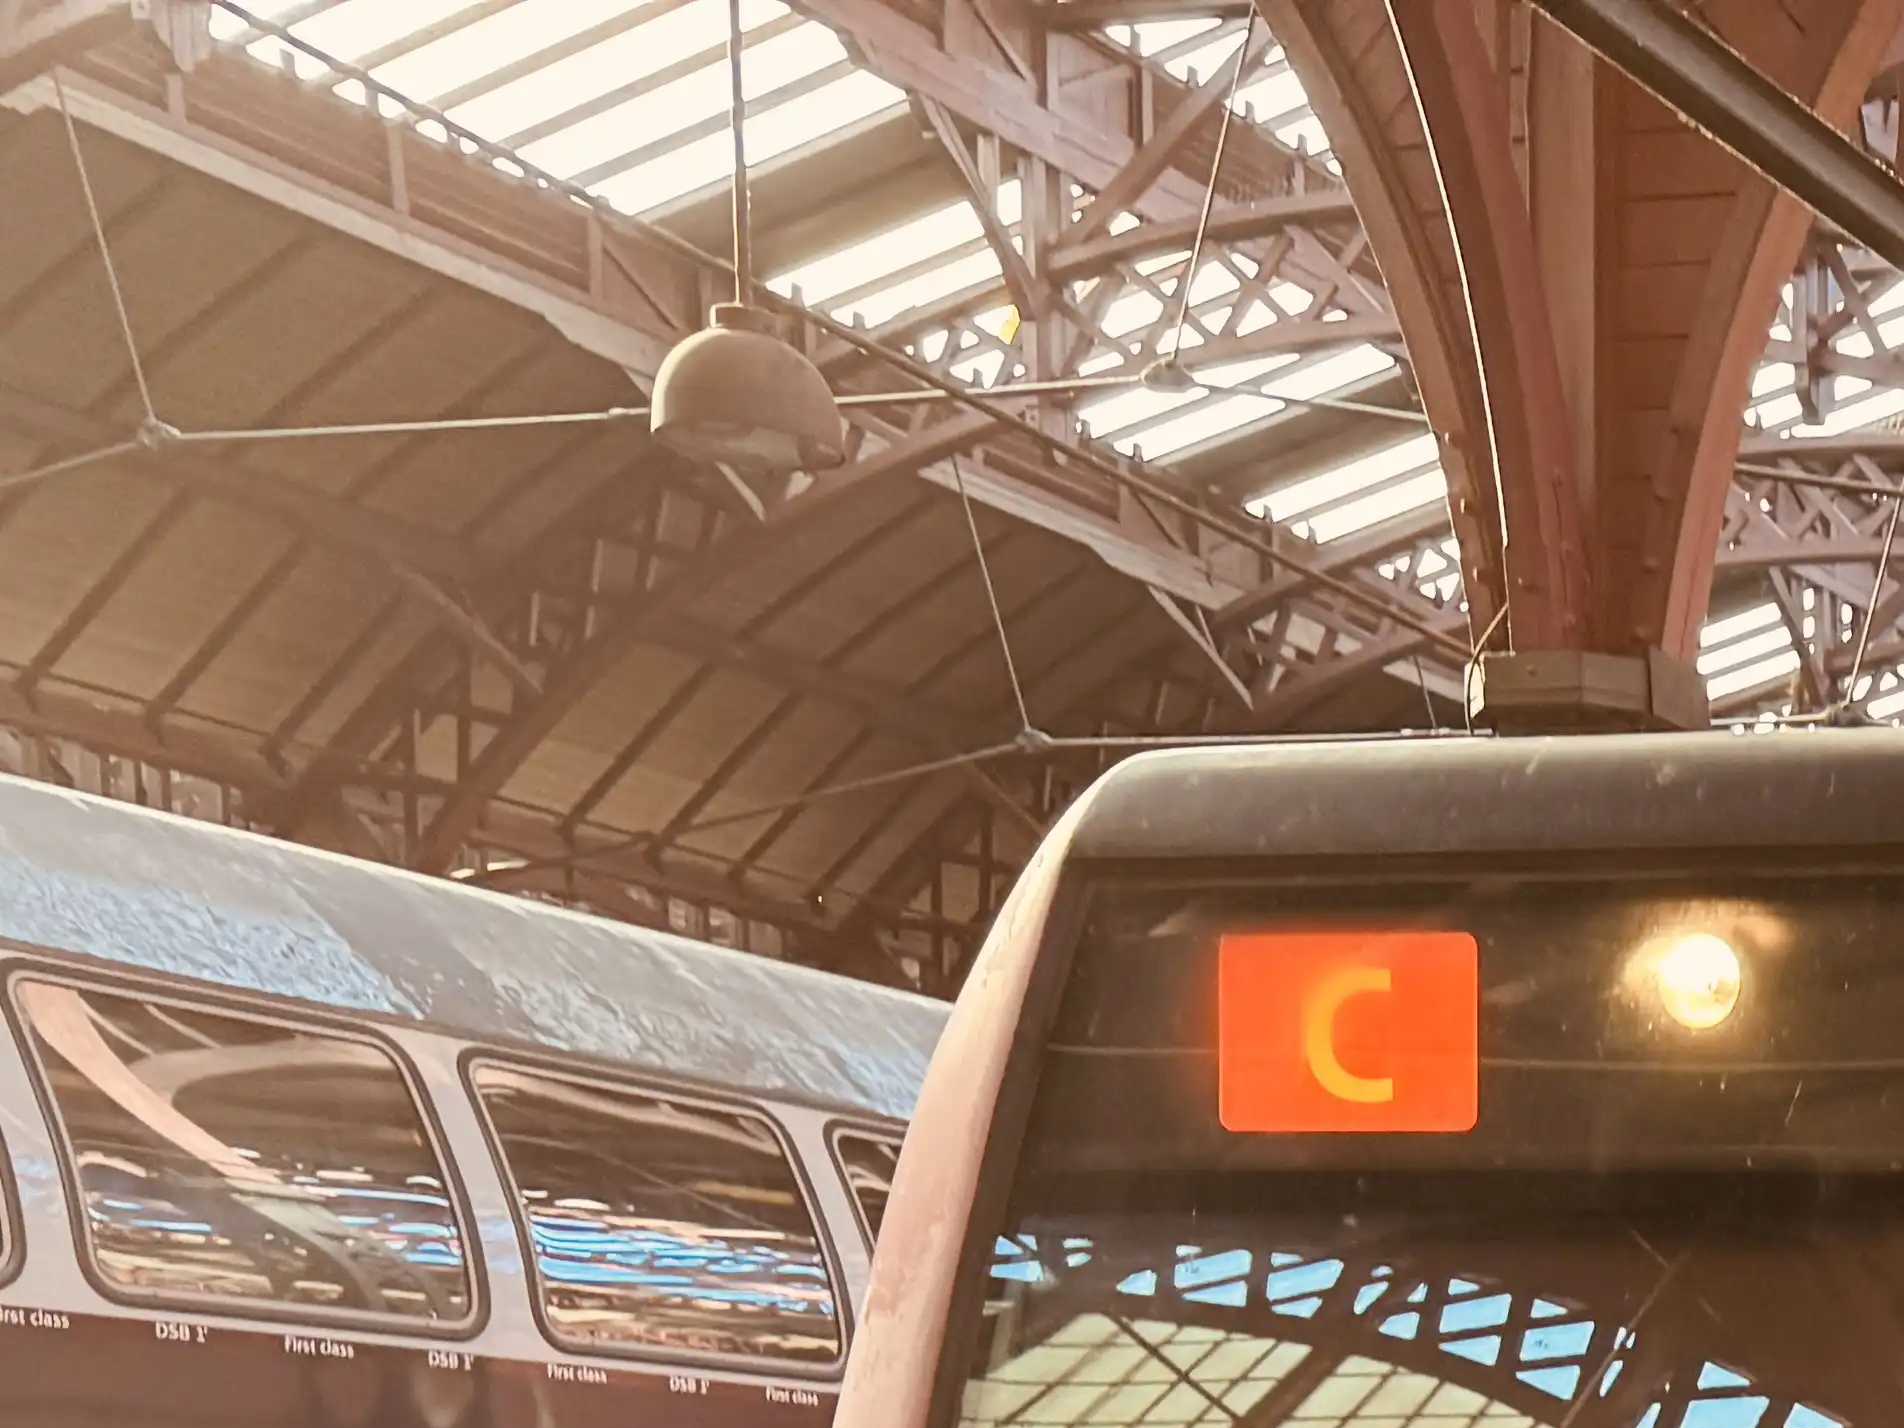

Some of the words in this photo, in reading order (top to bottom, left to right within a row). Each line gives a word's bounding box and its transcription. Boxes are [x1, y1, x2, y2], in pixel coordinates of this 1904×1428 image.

[1305, 967, 1393, 1104] C
[0, 1305, 26, 1327] irst
[29, 1307, 71, 1329] class
[284, 1334, 317, 1356] First
[320, 1337, 355, 1359] class
